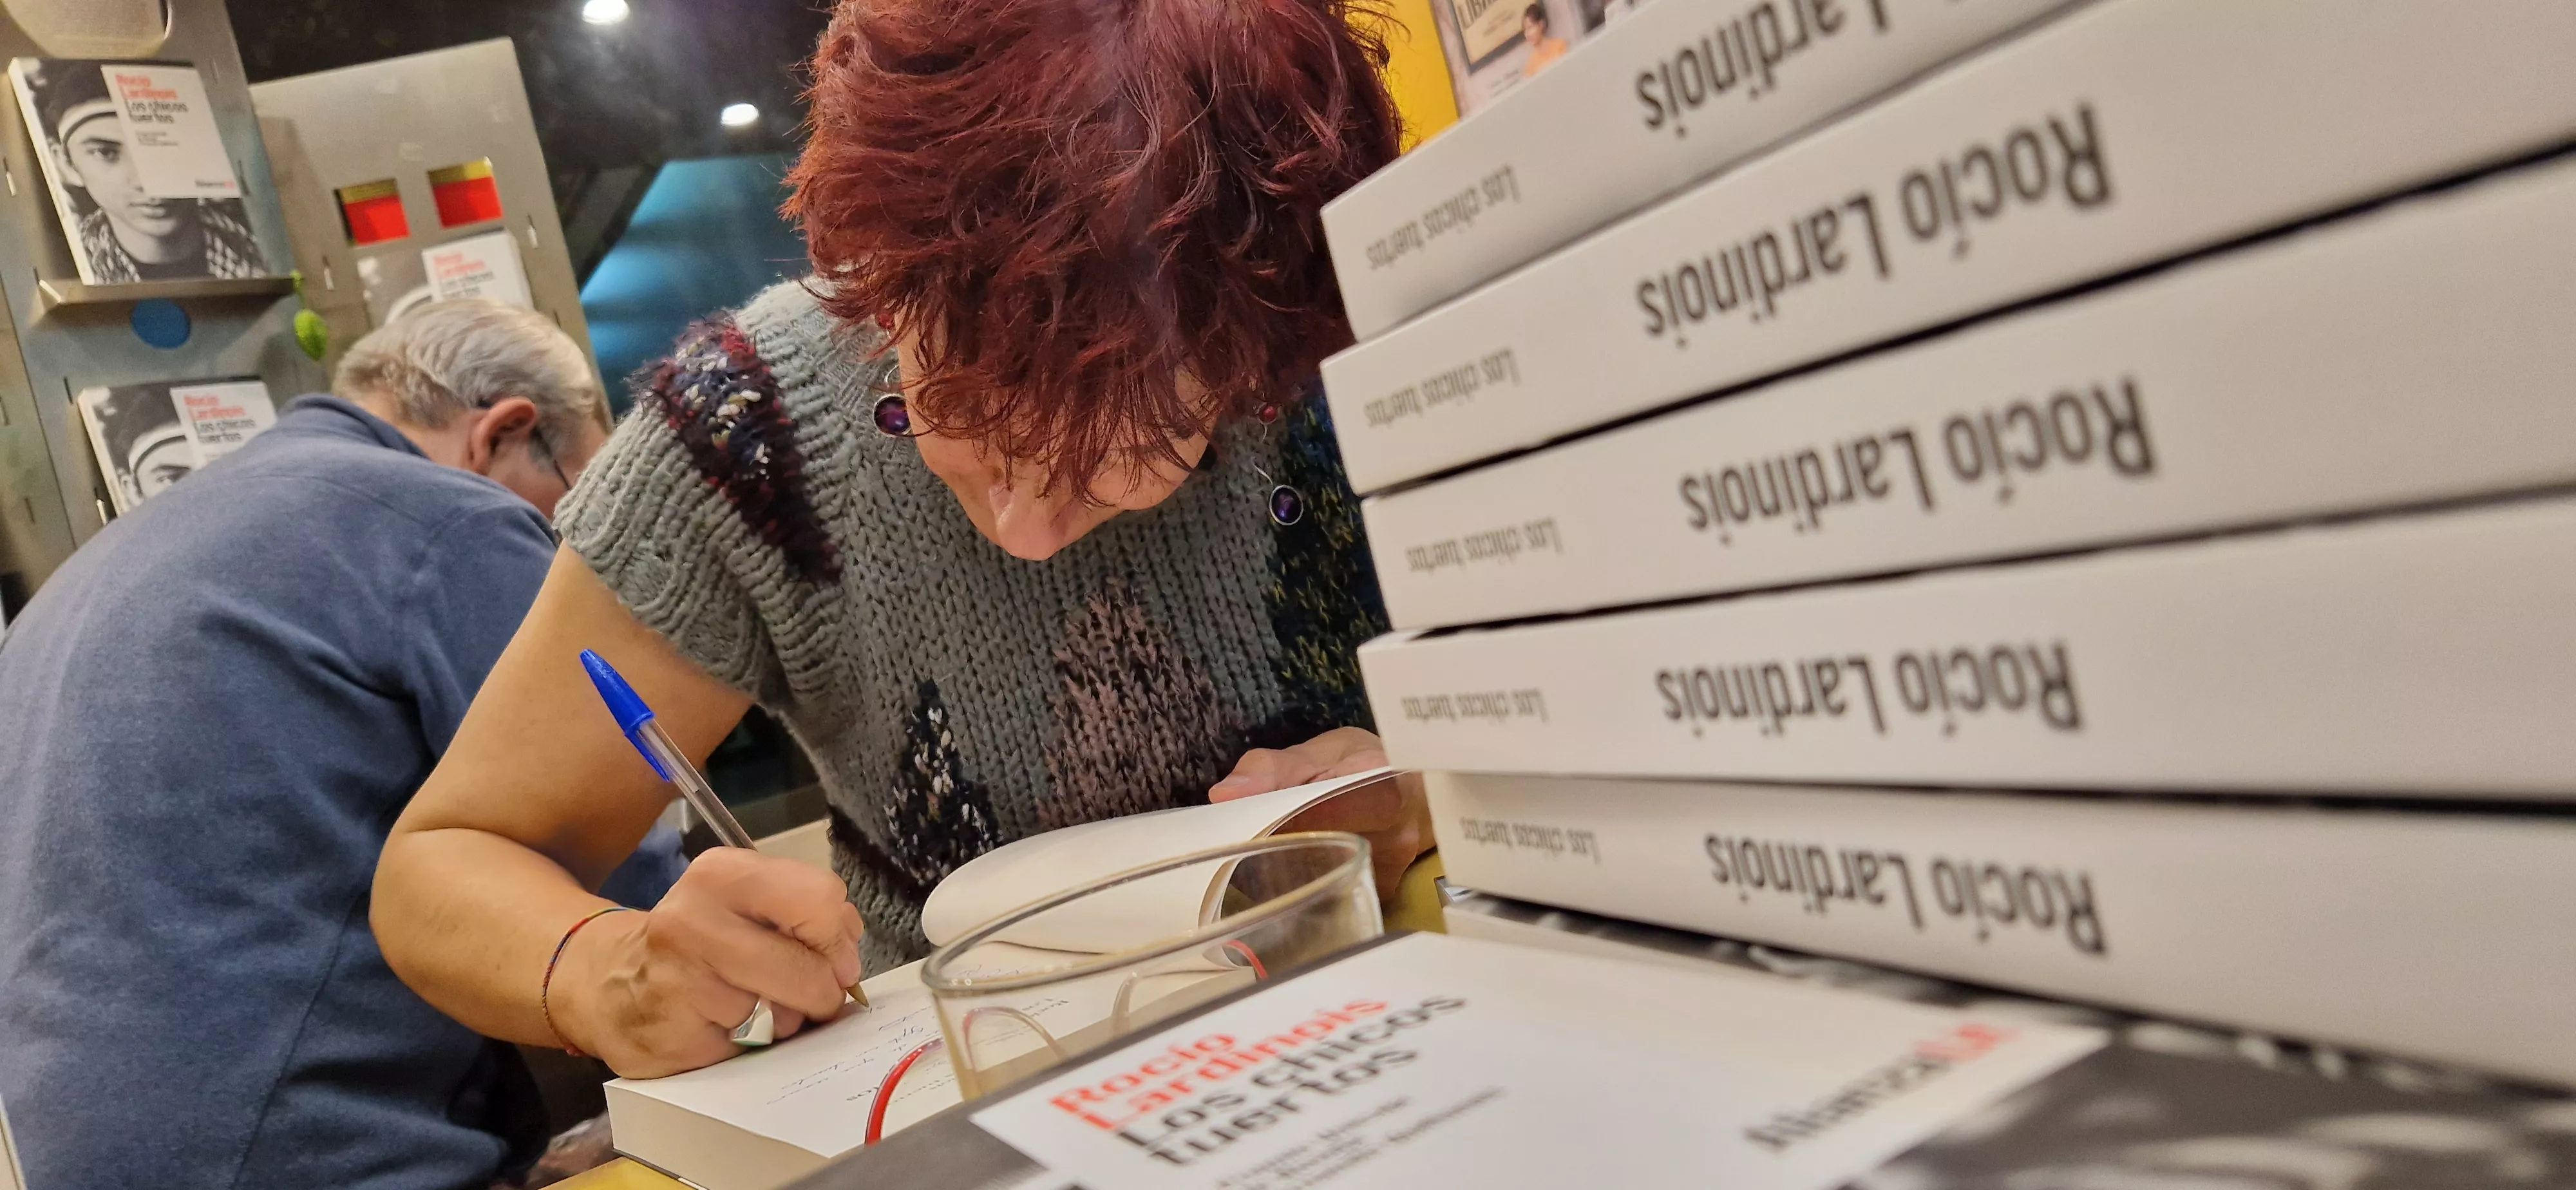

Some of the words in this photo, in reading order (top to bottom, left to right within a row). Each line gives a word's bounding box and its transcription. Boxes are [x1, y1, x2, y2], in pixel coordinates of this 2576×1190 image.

[1636, 189, 1892, 348] Lardinois
[1680, 426, 1936, 546] Lardinois
[1655, 654, 1888, 737] Lardinois
[1704, 835, 1923, 930] Lardinois
[1080, 998, 1388, 1130] Lardinois
[1116, 1091, 1246, 1149] Los
[1251, 995, 1467, 1090] chicos
[1148, 1048, 1418, 1166] tuertos
